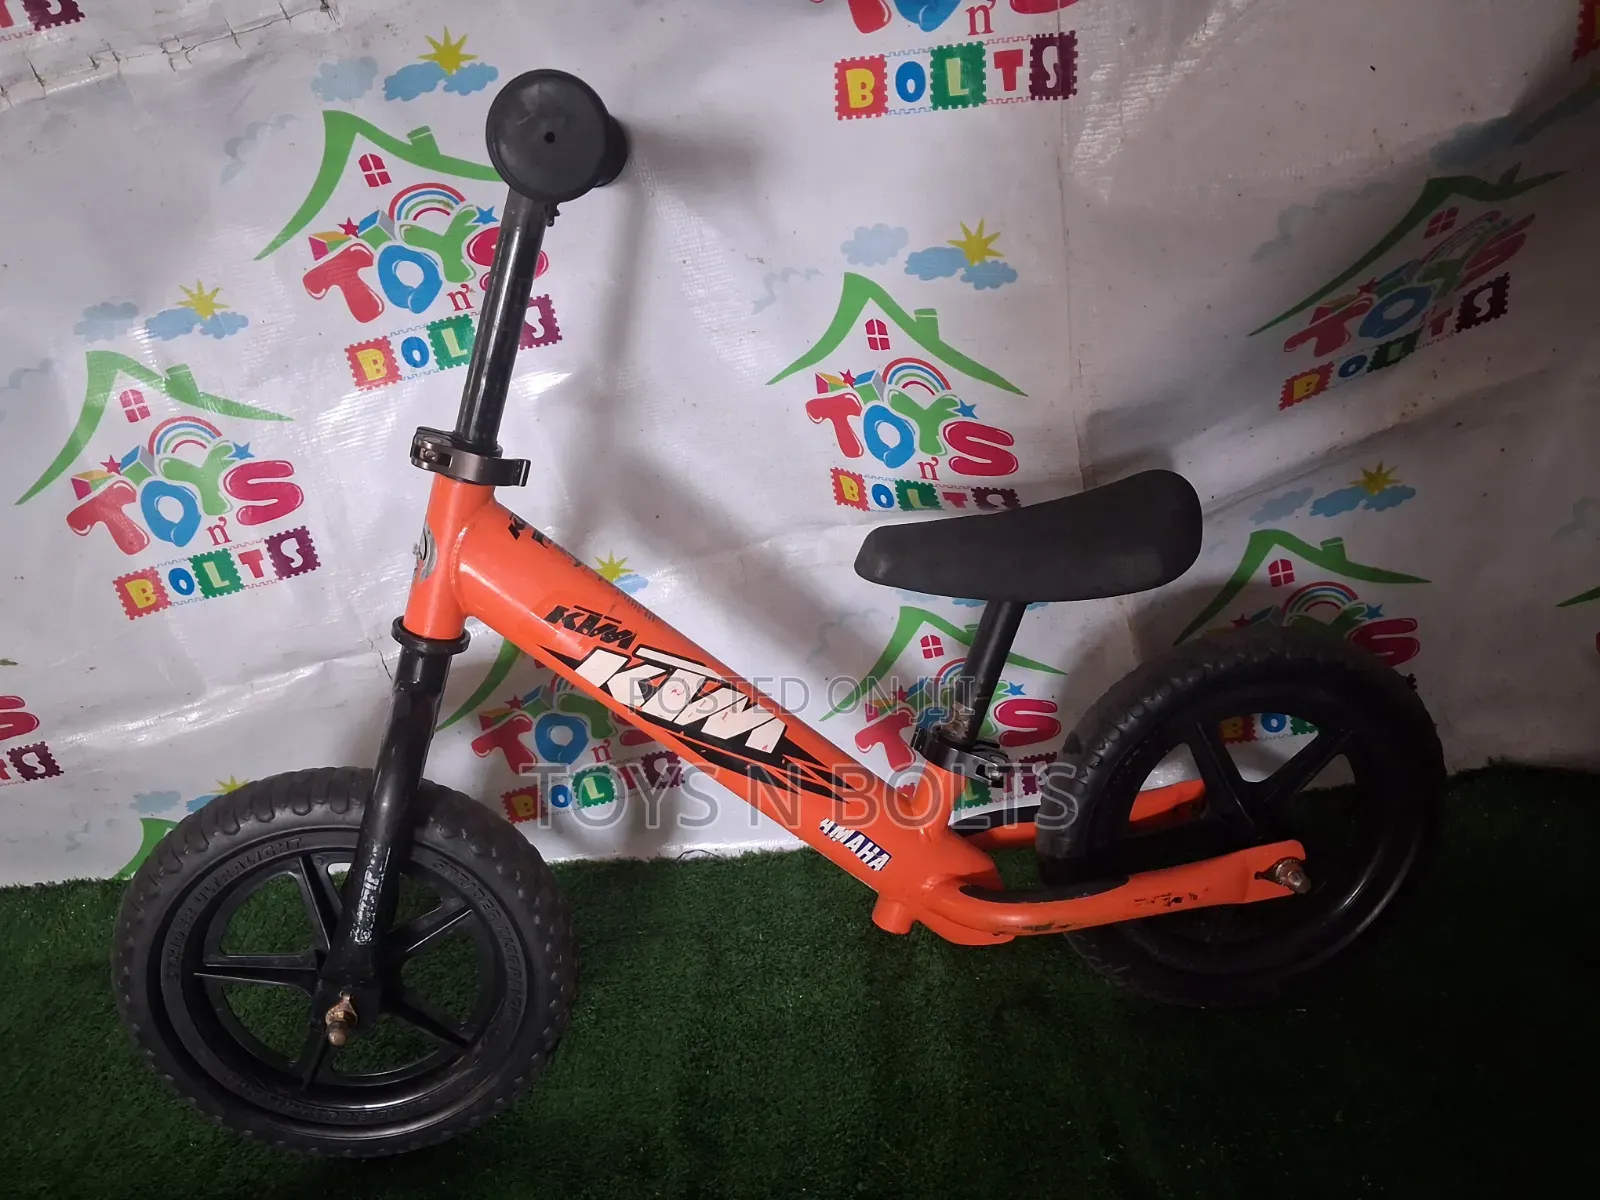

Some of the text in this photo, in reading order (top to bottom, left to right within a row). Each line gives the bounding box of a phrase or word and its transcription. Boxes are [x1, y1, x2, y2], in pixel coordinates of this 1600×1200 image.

[844, 43, 1063, 109] BOLTS
[447, 283, 475, 311] n'
[1284, 213, 1536, 358] TOYS
[354, 305, 546, 382] BOLS
[805, 388, 1020, 477] TOYS
[66, 439, 305, 555] TOYS
[916, 457, 940, 480] n'
[205, 516, 230, 546] n'
[124, 536, 305, 609] BOLTS
[543, 604, 638, 650] KTM
[574, 645, 787, 755] KTM
[590, 739, 613, 763] n'
